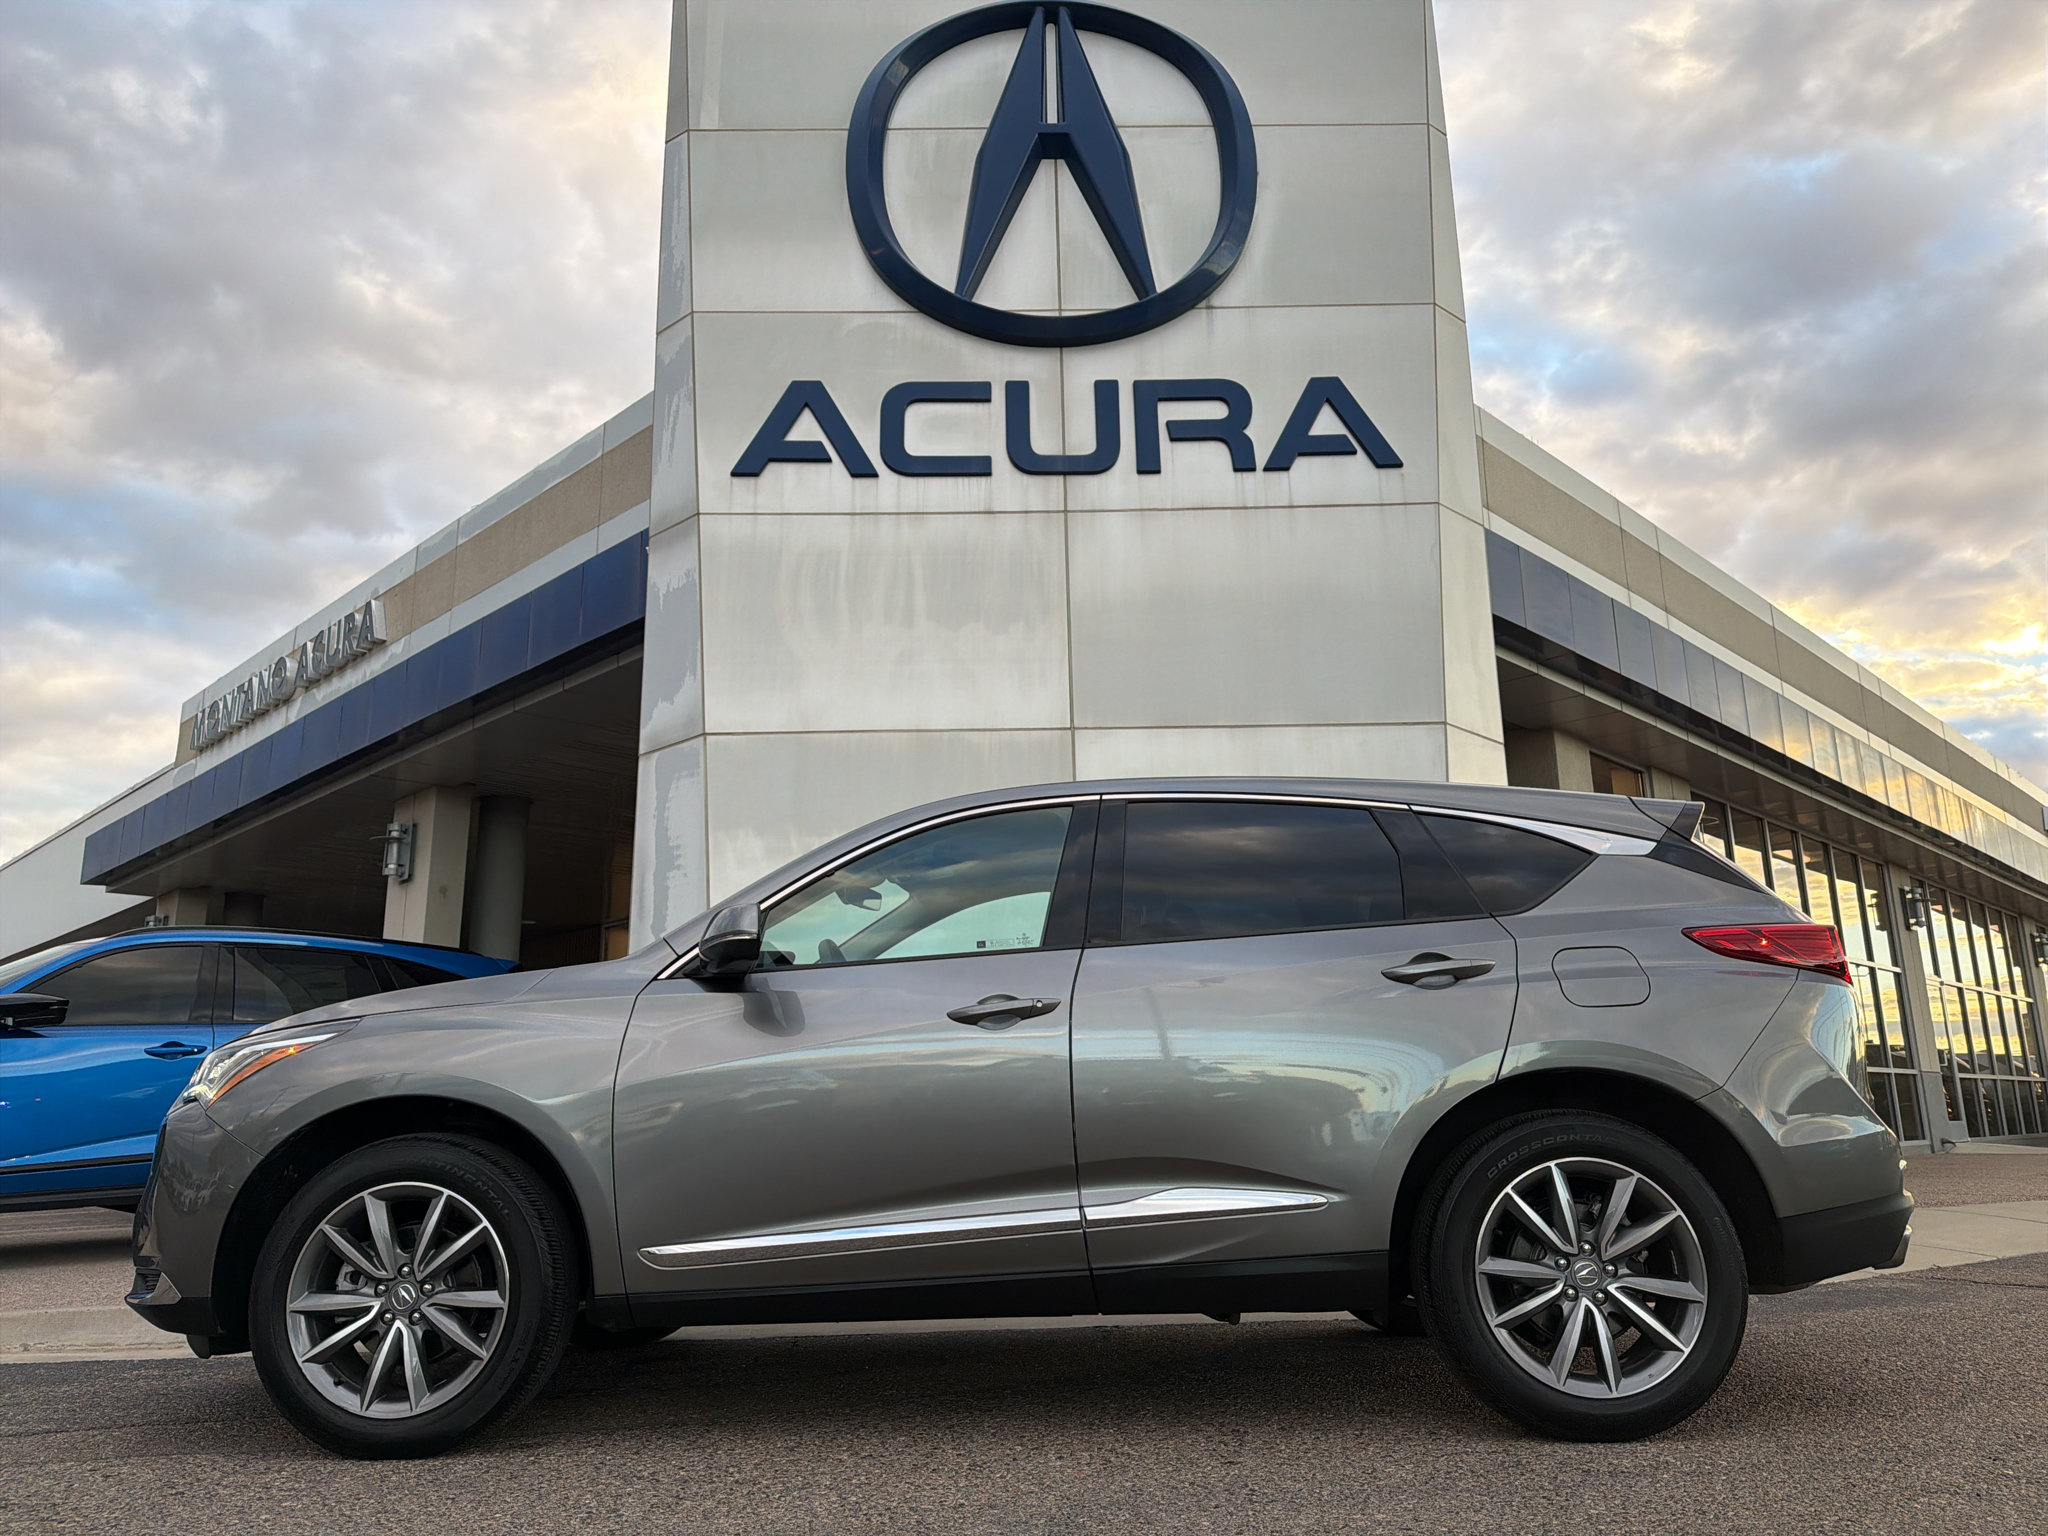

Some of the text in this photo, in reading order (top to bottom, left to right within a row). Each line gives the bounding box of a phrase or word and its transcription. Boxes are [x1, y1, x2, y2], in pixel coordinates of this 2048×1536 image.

[730, 376, 1404, 477] ACURA
[189, 599, 388, 750] MONTANO ACURA
[1486, 1132, 1624, 1181] CROSSCONTAC
